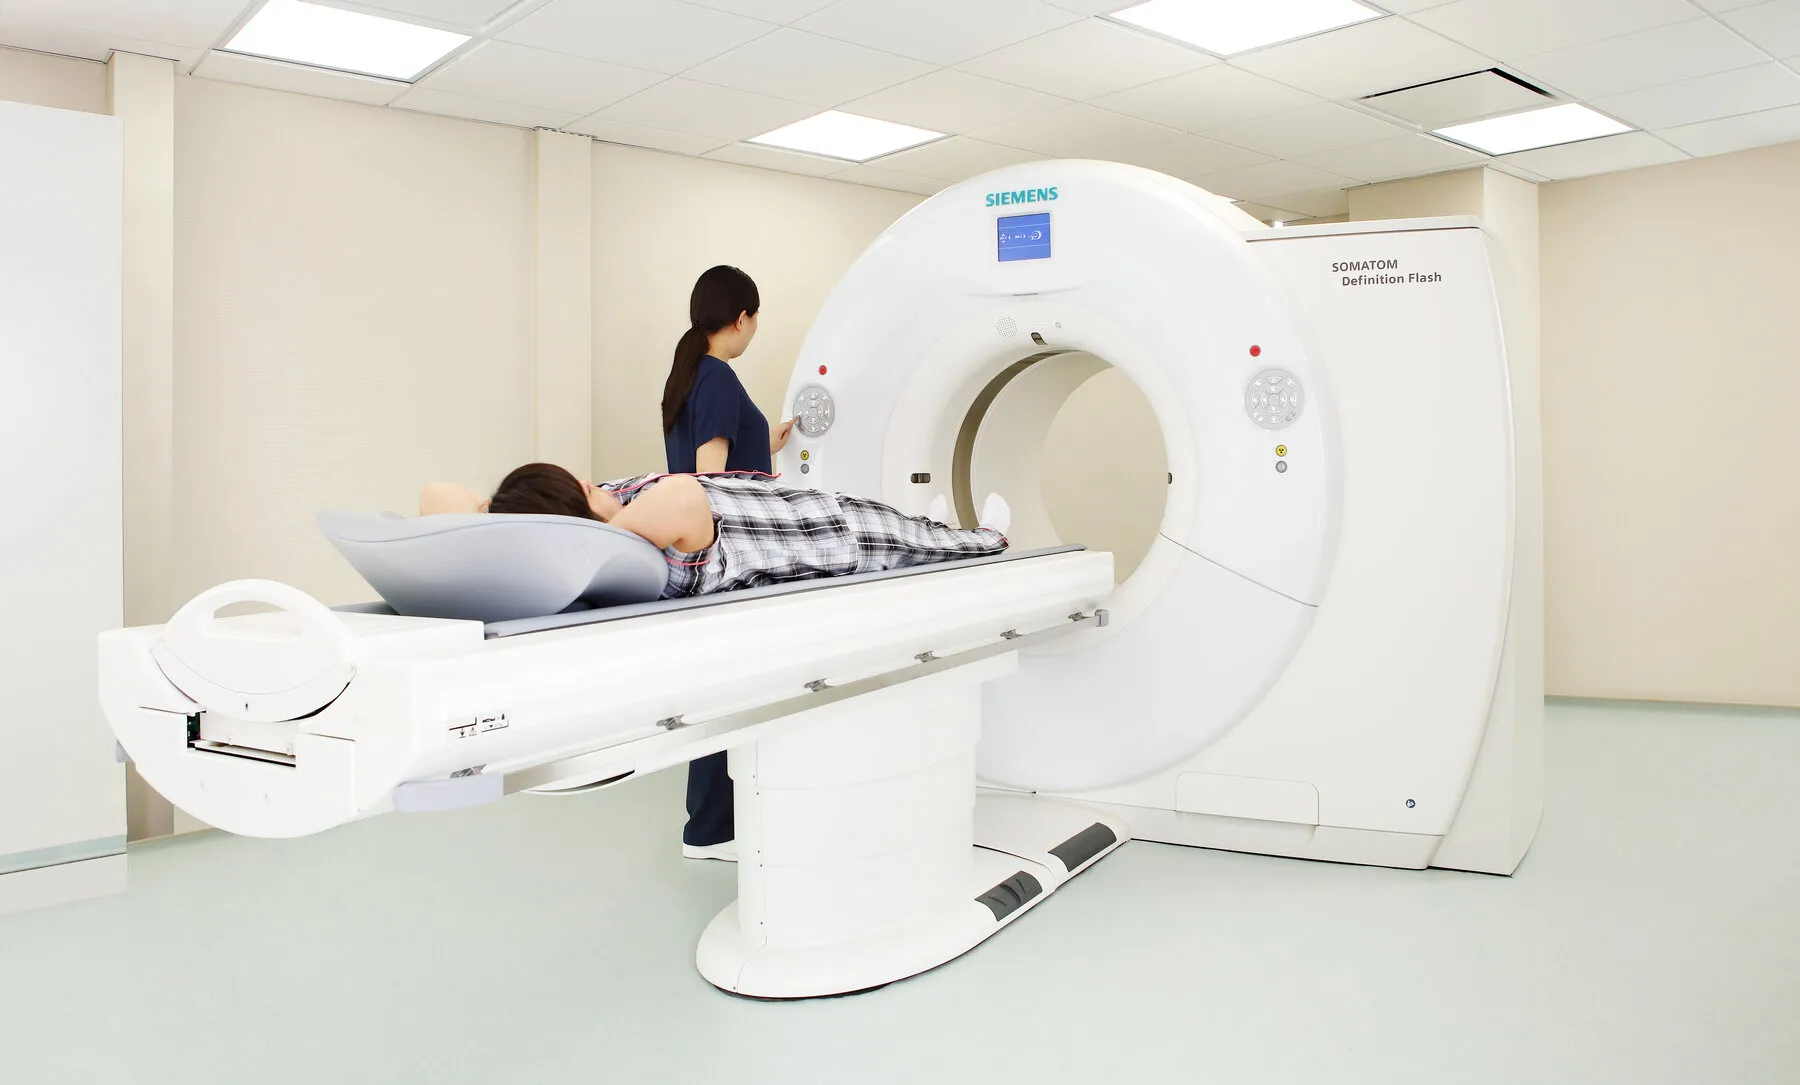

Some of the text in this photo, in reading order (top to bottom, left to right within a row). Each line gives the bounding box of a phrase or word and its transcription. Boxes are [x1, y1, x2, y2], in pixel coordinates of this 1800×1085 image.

[985, 186, 1058, 207] SIEMENS
[1332, 259, 1398, 272] SOMATOM
[1342, 272, 1442, 286] Definition Flash
